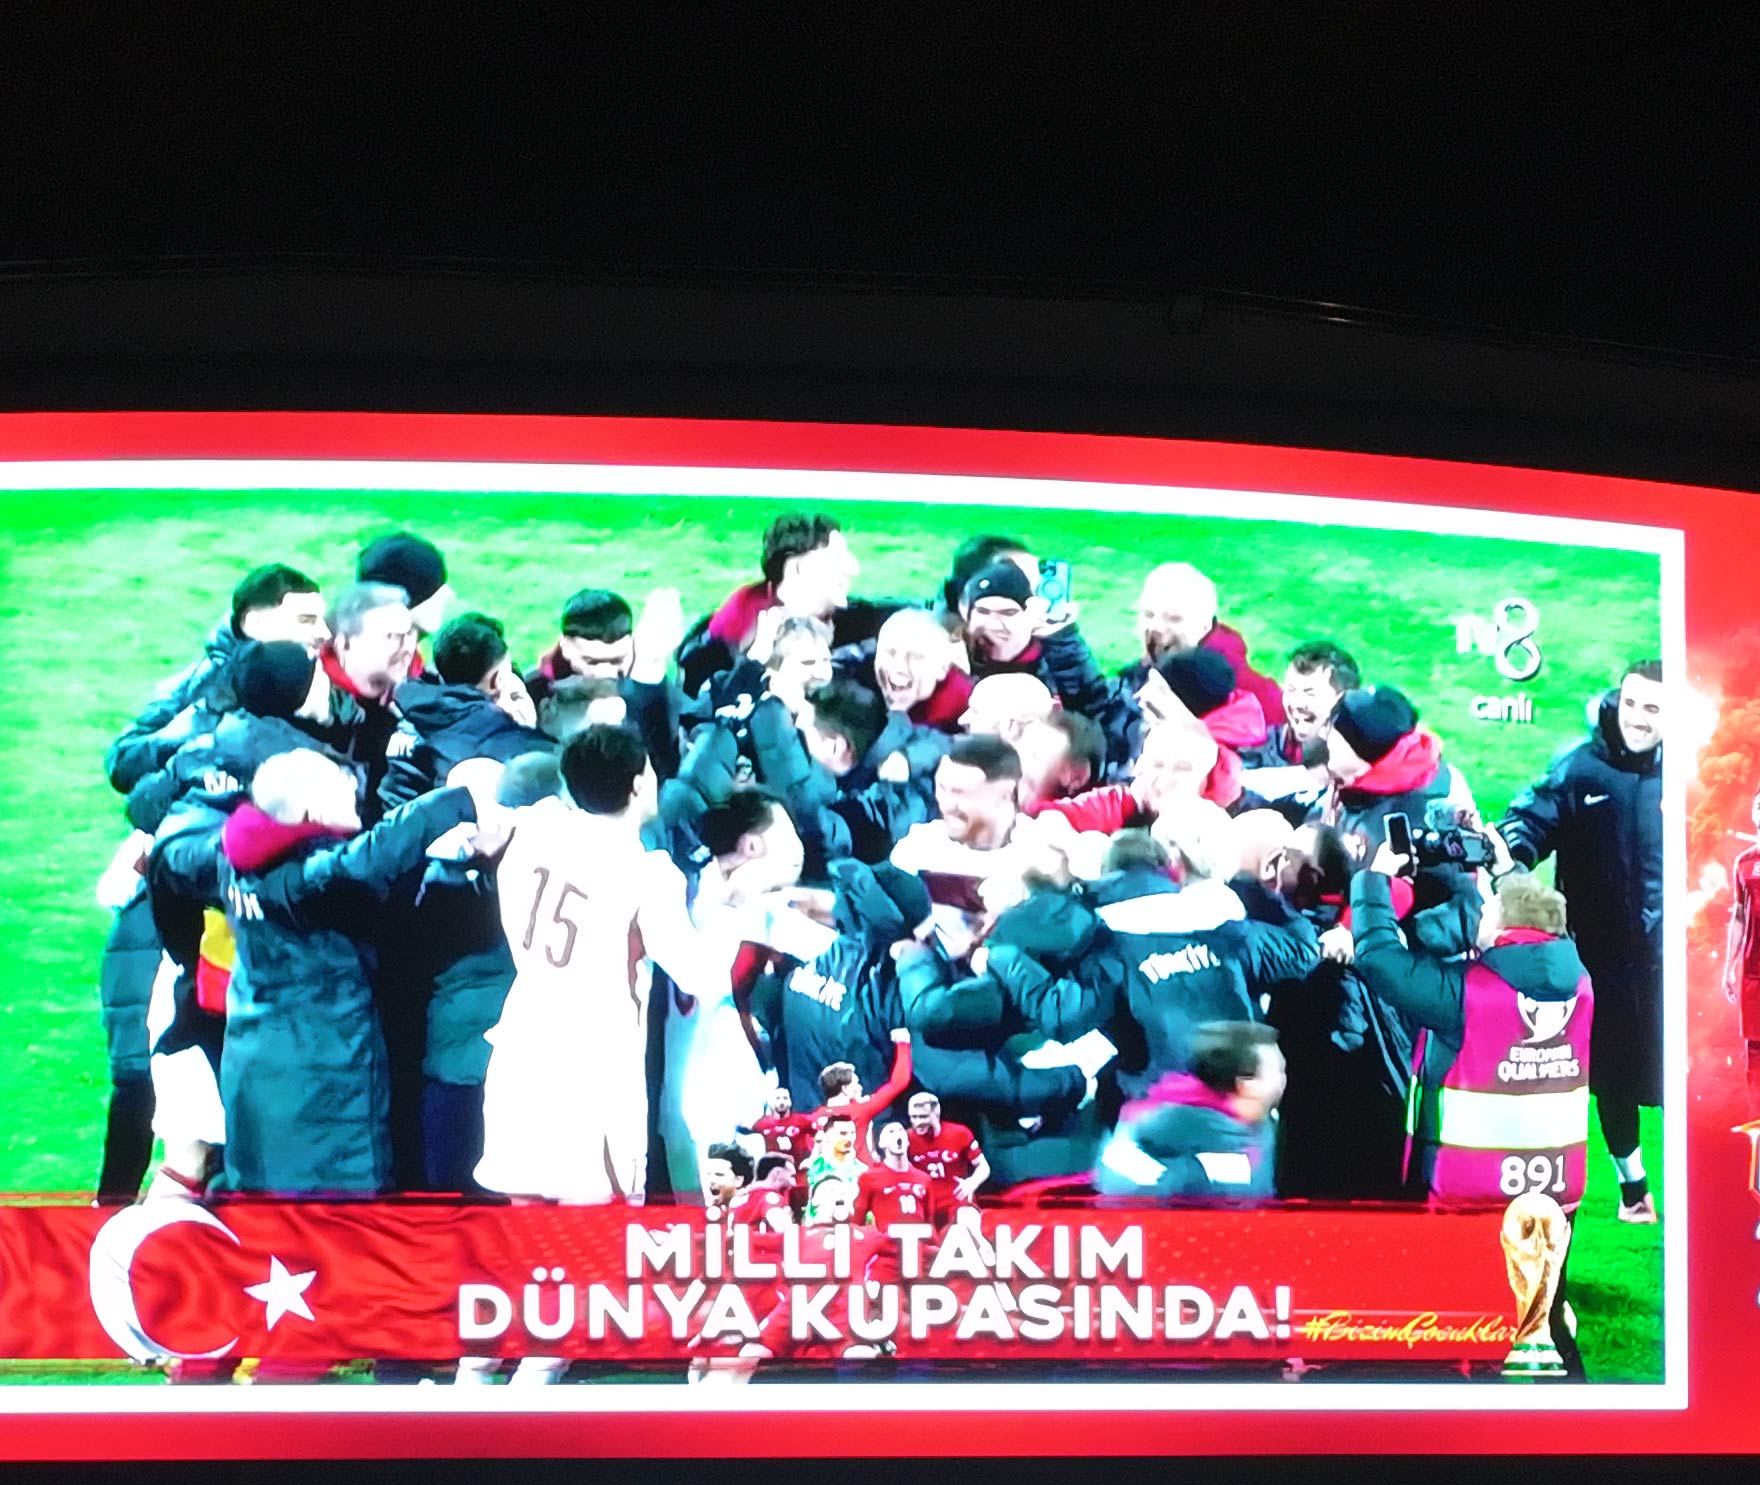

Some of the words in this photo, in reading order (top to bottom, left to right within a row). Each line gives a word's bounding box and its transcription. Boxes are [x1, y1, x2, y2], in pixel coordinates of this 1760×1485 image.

[523, 867, 588, 968] 15
[1500, 1154, 1566, 1196] 891
[626, 1206, 851, 1279] MİLLİ
[888, 1223, 1143, 1279] TAKIM
[458, 1266, 762, 1341] DÜNYA
